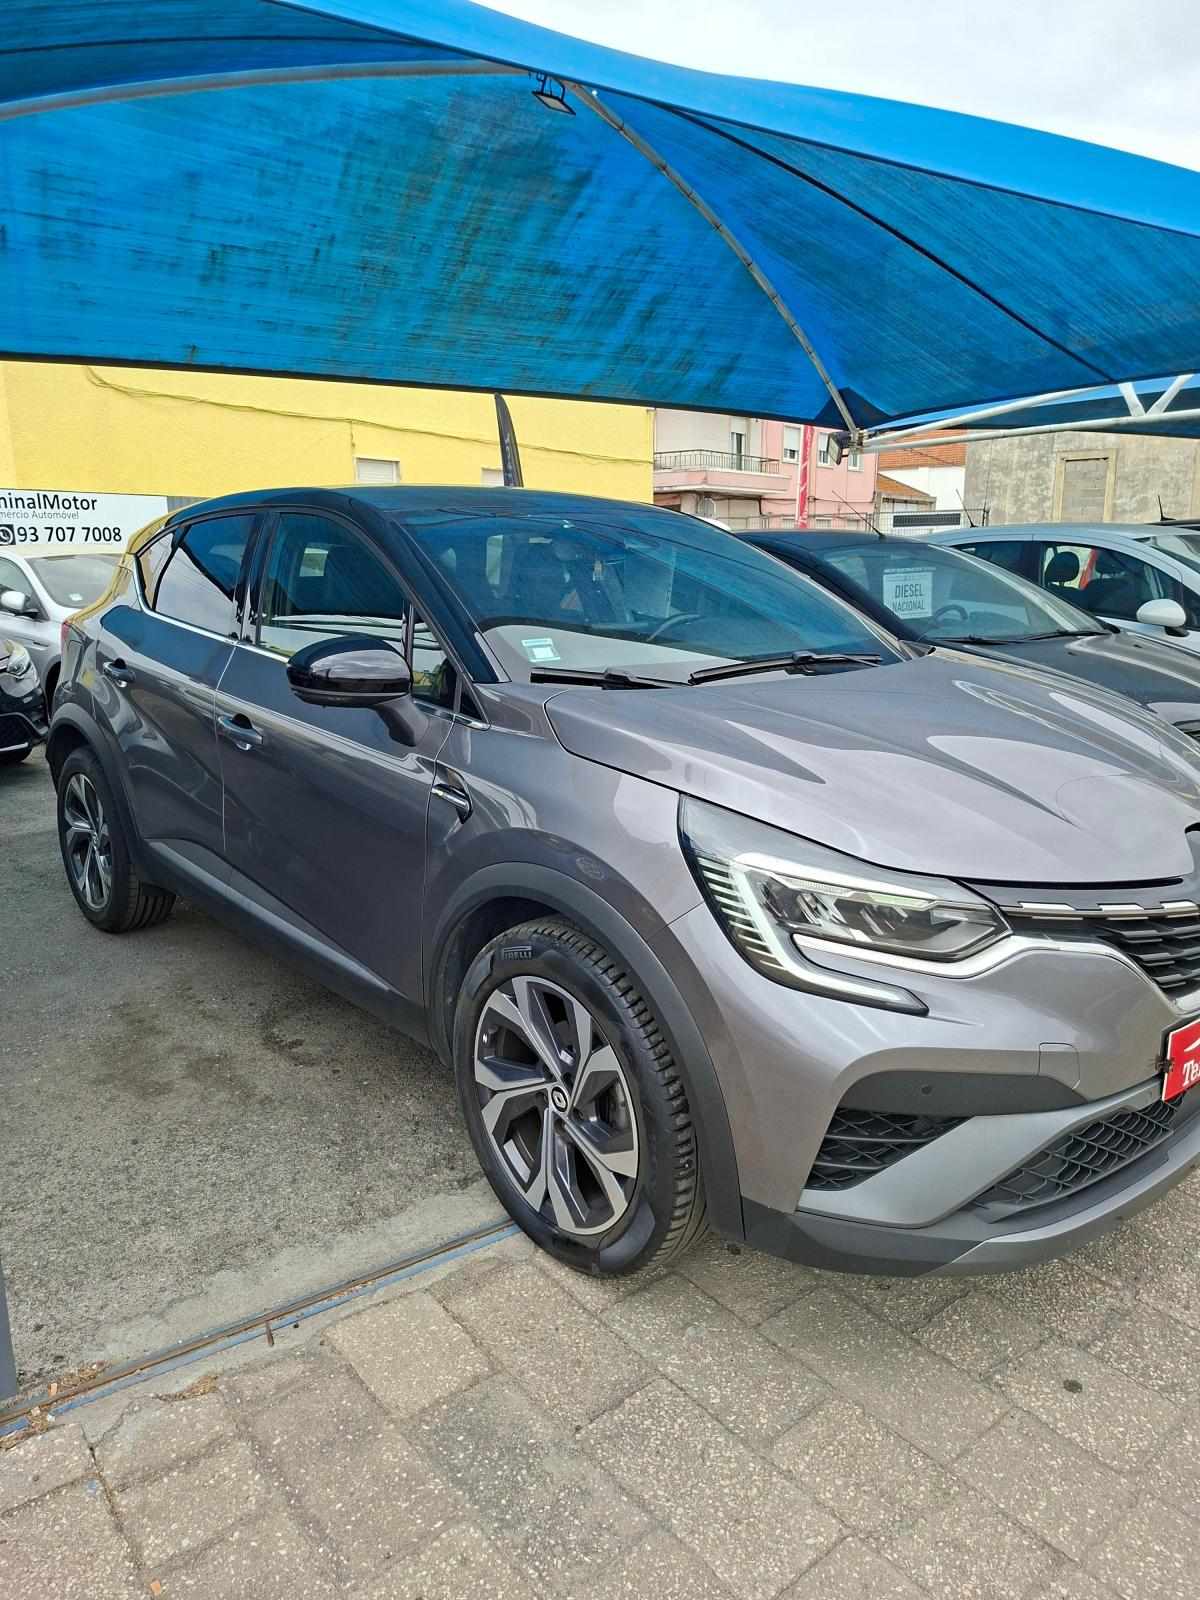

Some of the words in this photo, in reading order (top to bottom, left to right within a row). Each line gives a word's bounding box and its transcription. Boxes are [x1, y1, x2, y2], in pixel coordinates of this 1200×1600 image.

[31, 509, 79, 520] Automóvel
[17, 526, 39, 542] 93
[44, 526, 75, 542] 707
[82, 526, 122, 542] 7008
[895, 583, 925, 598] DIESEL
[892, 599, 926, 612] NACIONAL
